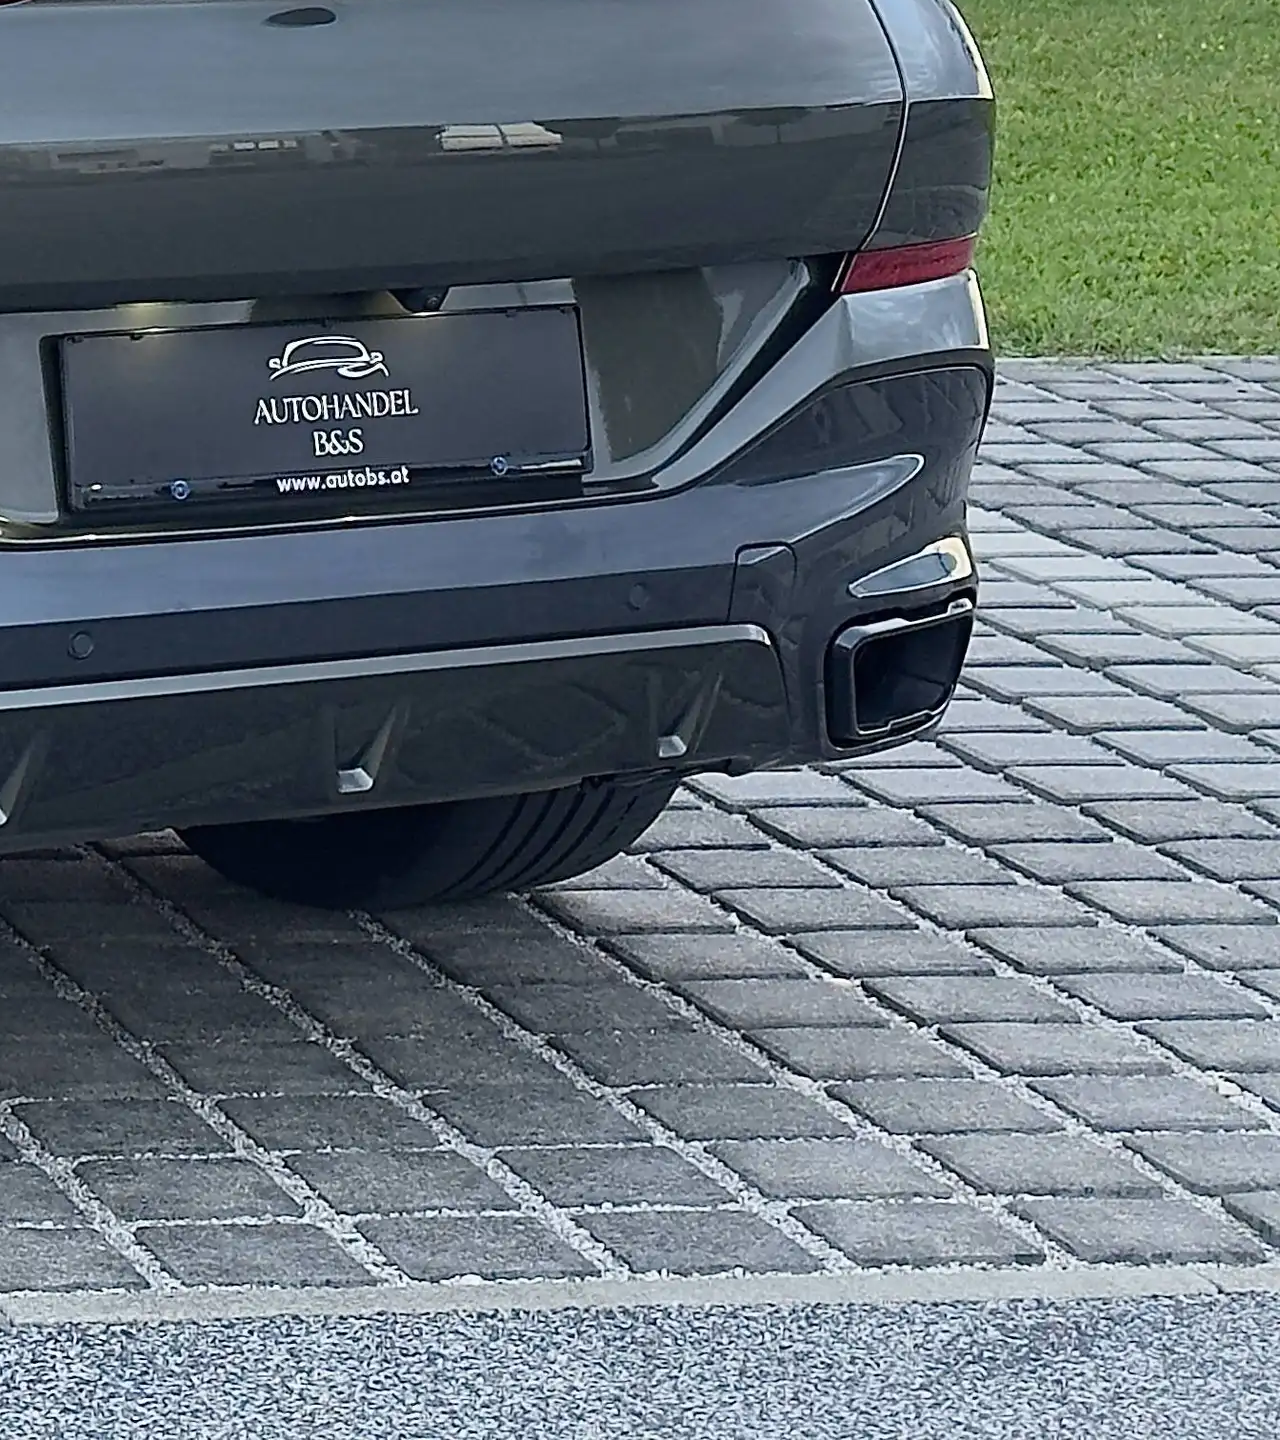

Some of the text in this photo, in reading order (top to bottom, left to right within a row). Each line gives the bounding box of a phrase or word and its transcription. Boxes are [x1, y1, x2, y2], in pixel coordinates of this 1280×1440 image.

[253, 389, 419, 425] AUTOHANDEL
[312, 428, 365, 457] B&S
[277, 467, 410, 492] www.autobs.at
